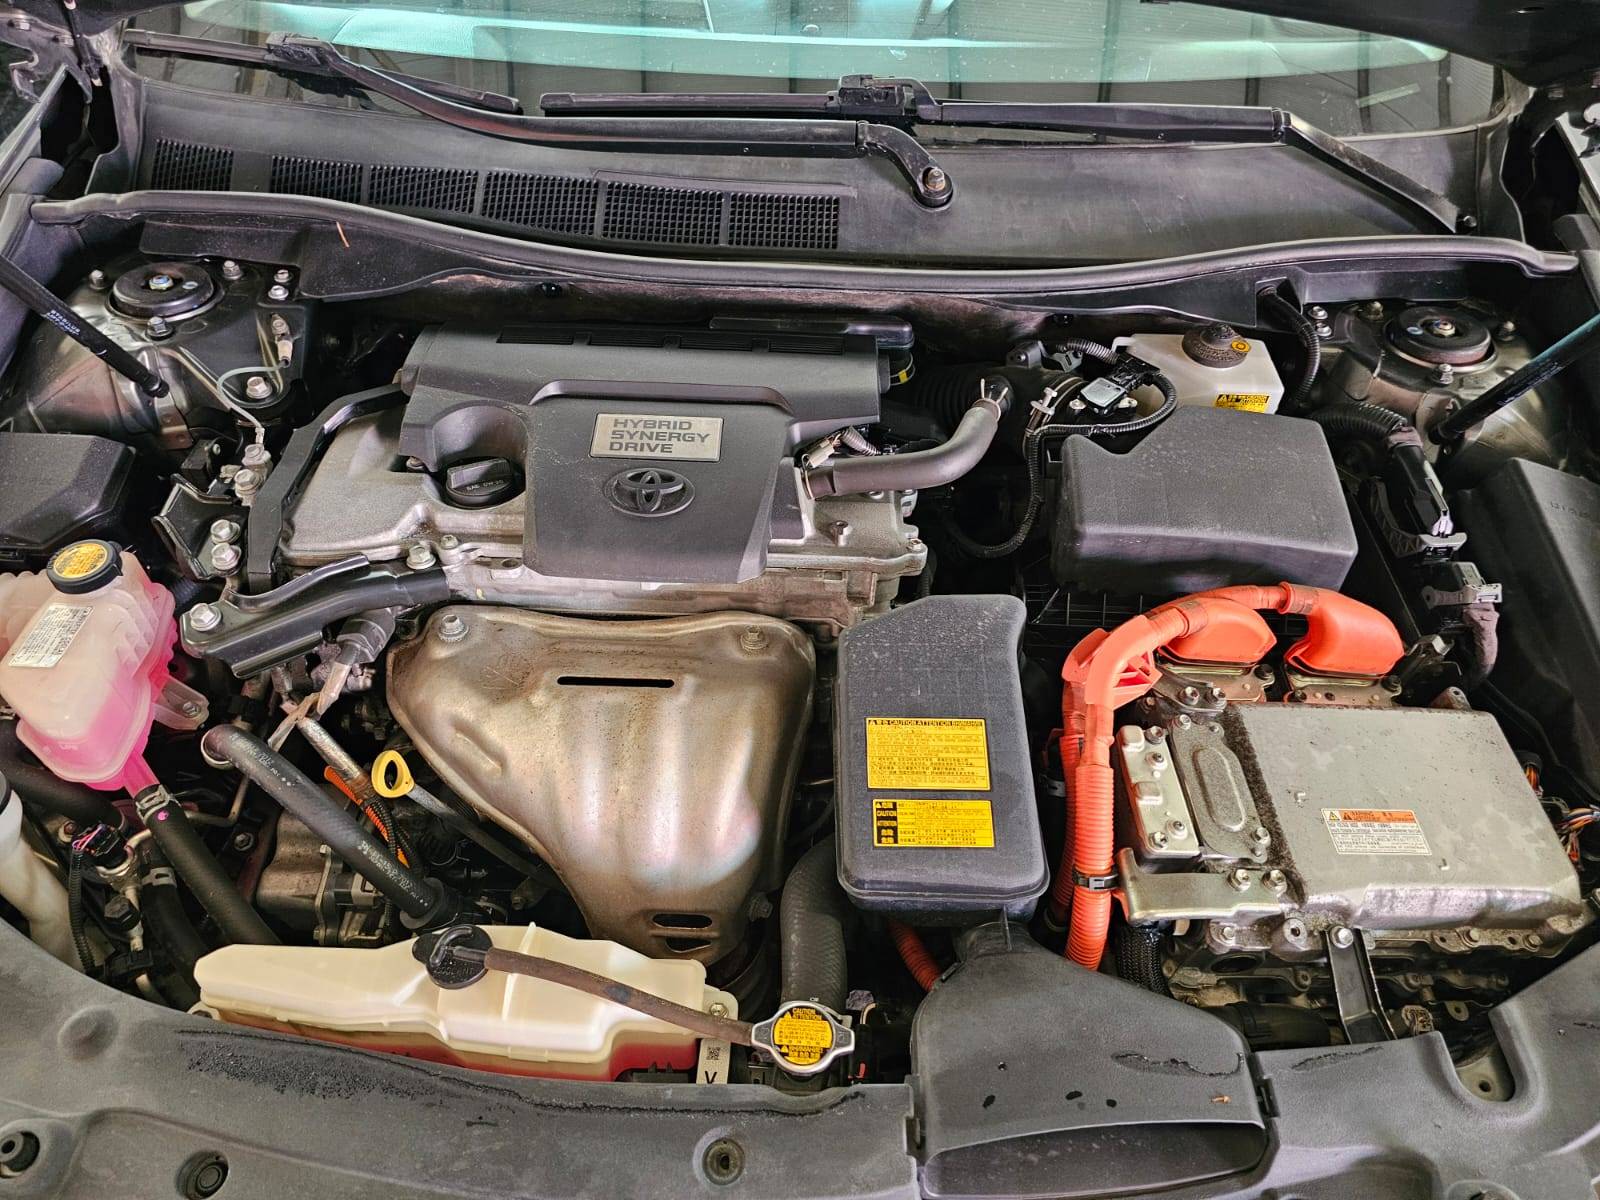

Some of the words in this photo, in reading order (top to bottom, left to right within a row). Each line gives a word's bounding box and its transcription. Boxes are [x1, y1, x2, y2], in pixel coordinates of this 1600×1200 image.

[613, 418, 692, 431] HYBRID
[610, 430, 711, 443] SYNERGY
[609, 441, 674, 454] DRIVE
